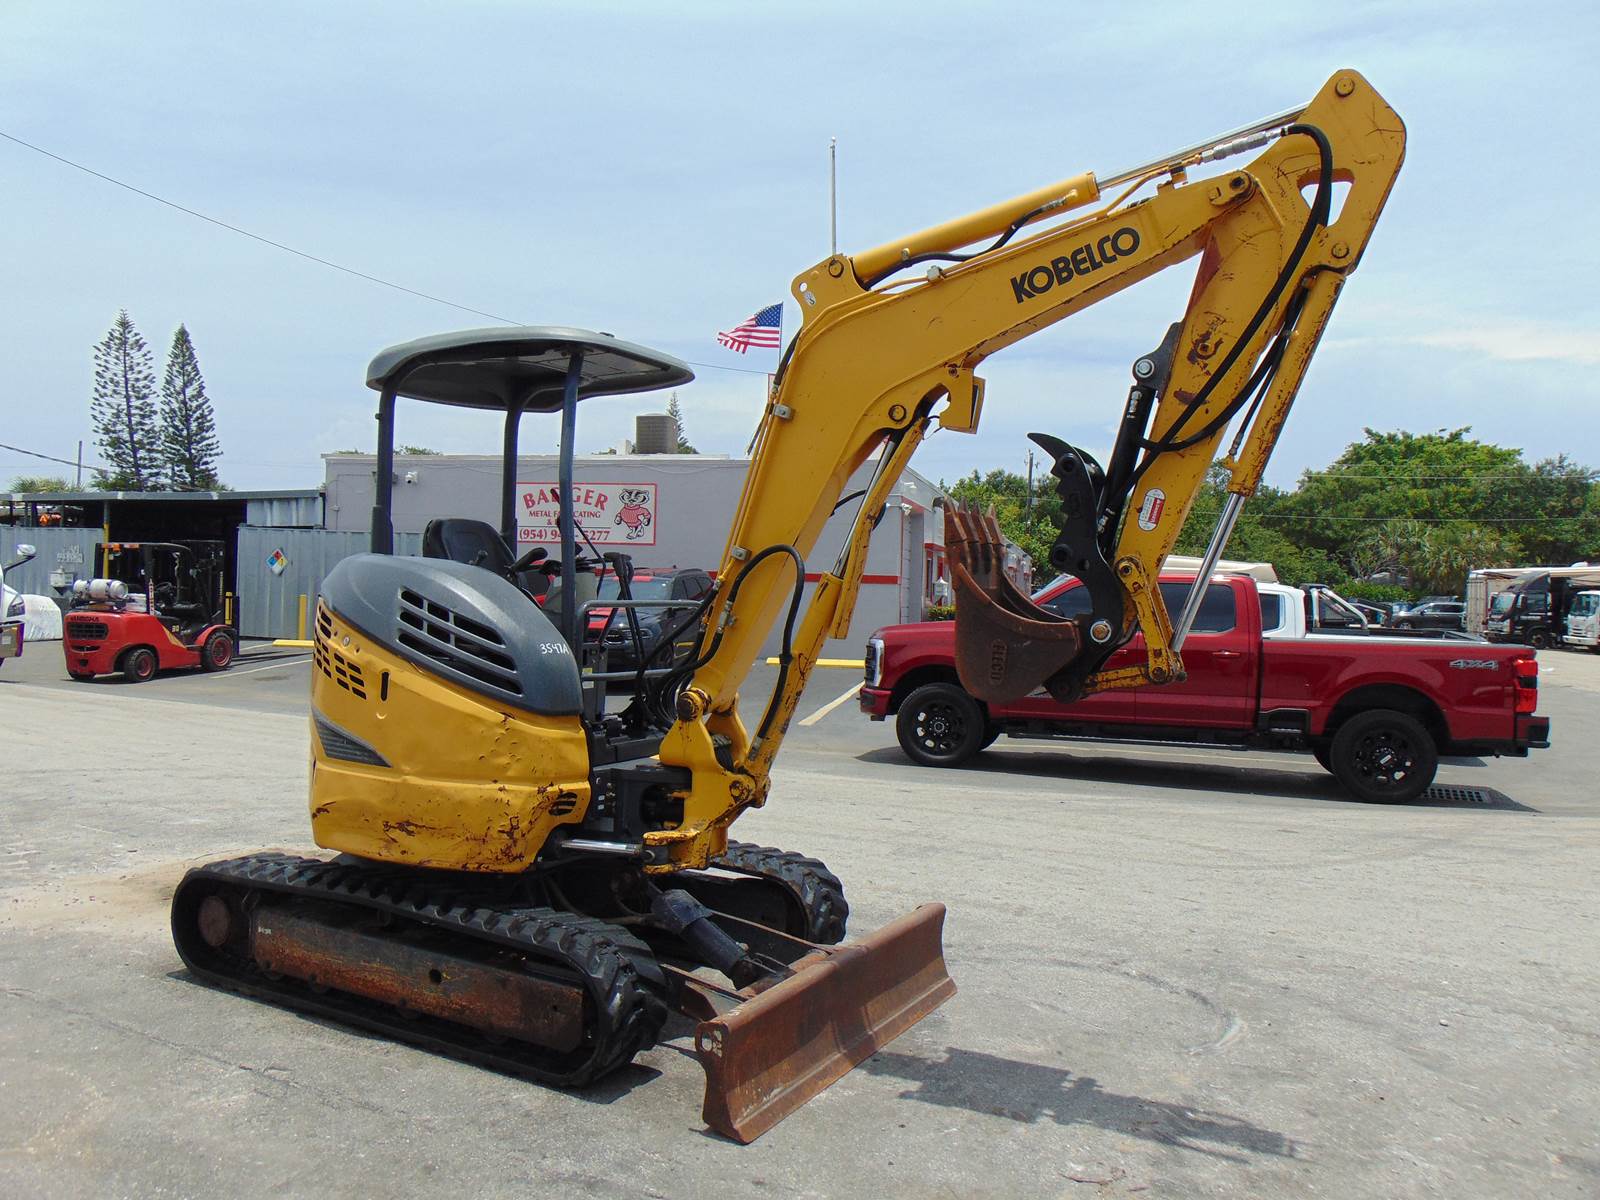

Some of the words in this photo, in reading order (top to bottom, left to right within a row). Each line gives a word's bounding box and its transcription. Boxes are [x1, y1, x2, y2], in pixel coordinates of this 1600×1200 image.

[1009, 227, 1140, 304] KOBELCO
[523, 487, 608, 511] BAGER
[529, 510, 552, 518] METAL
[553, 510, 601, 518] FCATING
[519, 528, 548, 540] (954)
[539, 642, 570, 655] 3547A
